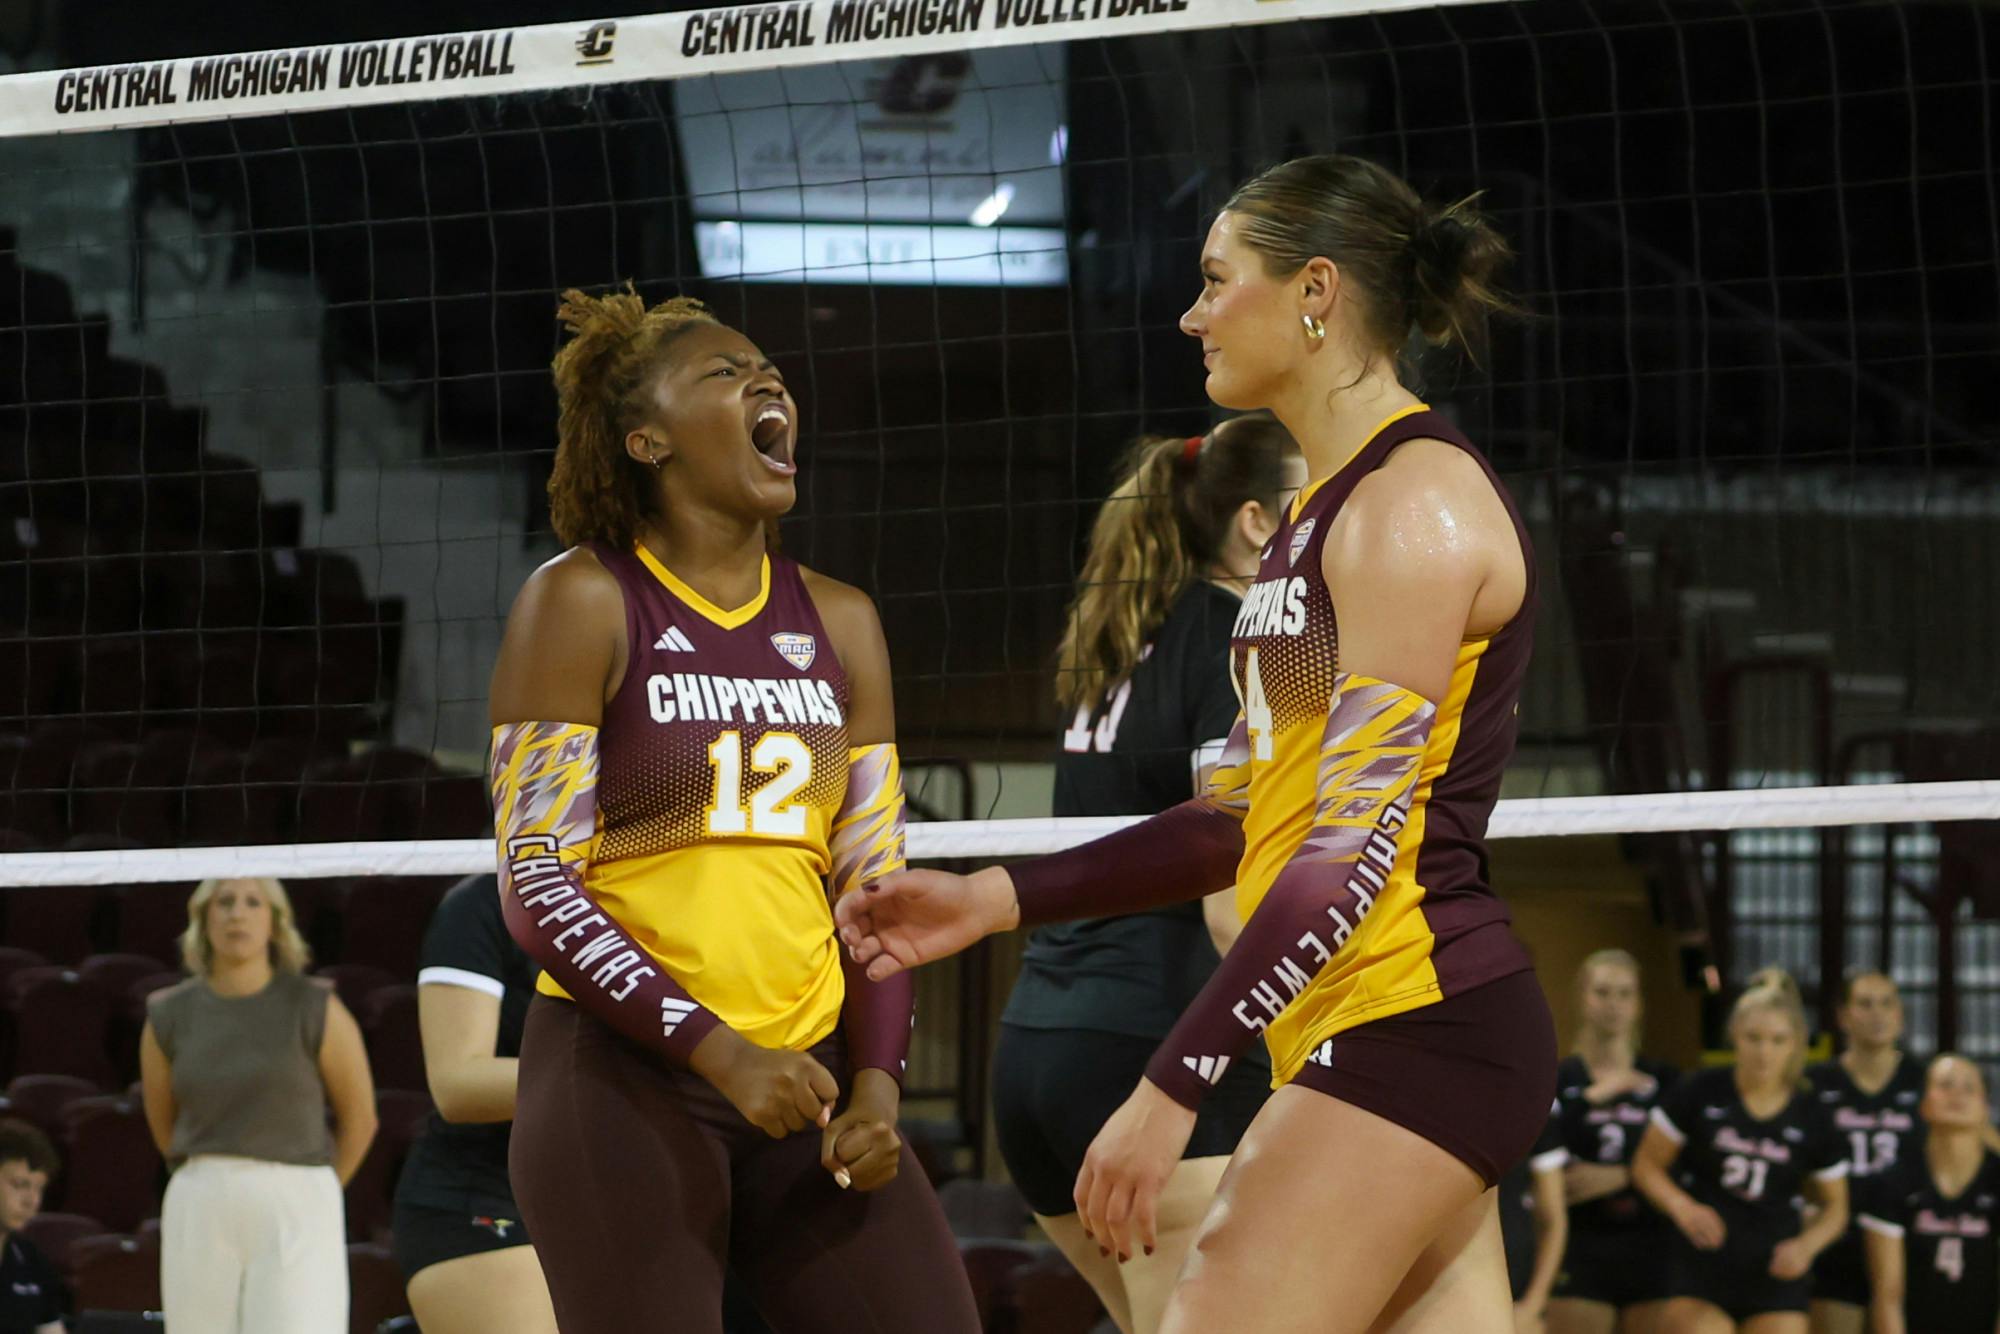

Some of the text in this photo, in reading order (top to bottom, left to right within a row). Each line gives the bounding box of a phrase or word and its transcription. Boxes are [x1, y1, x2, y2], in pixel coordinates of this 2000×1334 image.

[681, 0, 1188, 57] CENTRAL MICHIGAN VOLLE
[55, 31, 515, 114] CENTRAL MICHIGAN VOLLEYBALL
[647, 673, 843, 726] CHIPPEWAS
[708, 730, 813, 837] 12
[506, 833, 656, 1001] CHIPPEWAS
